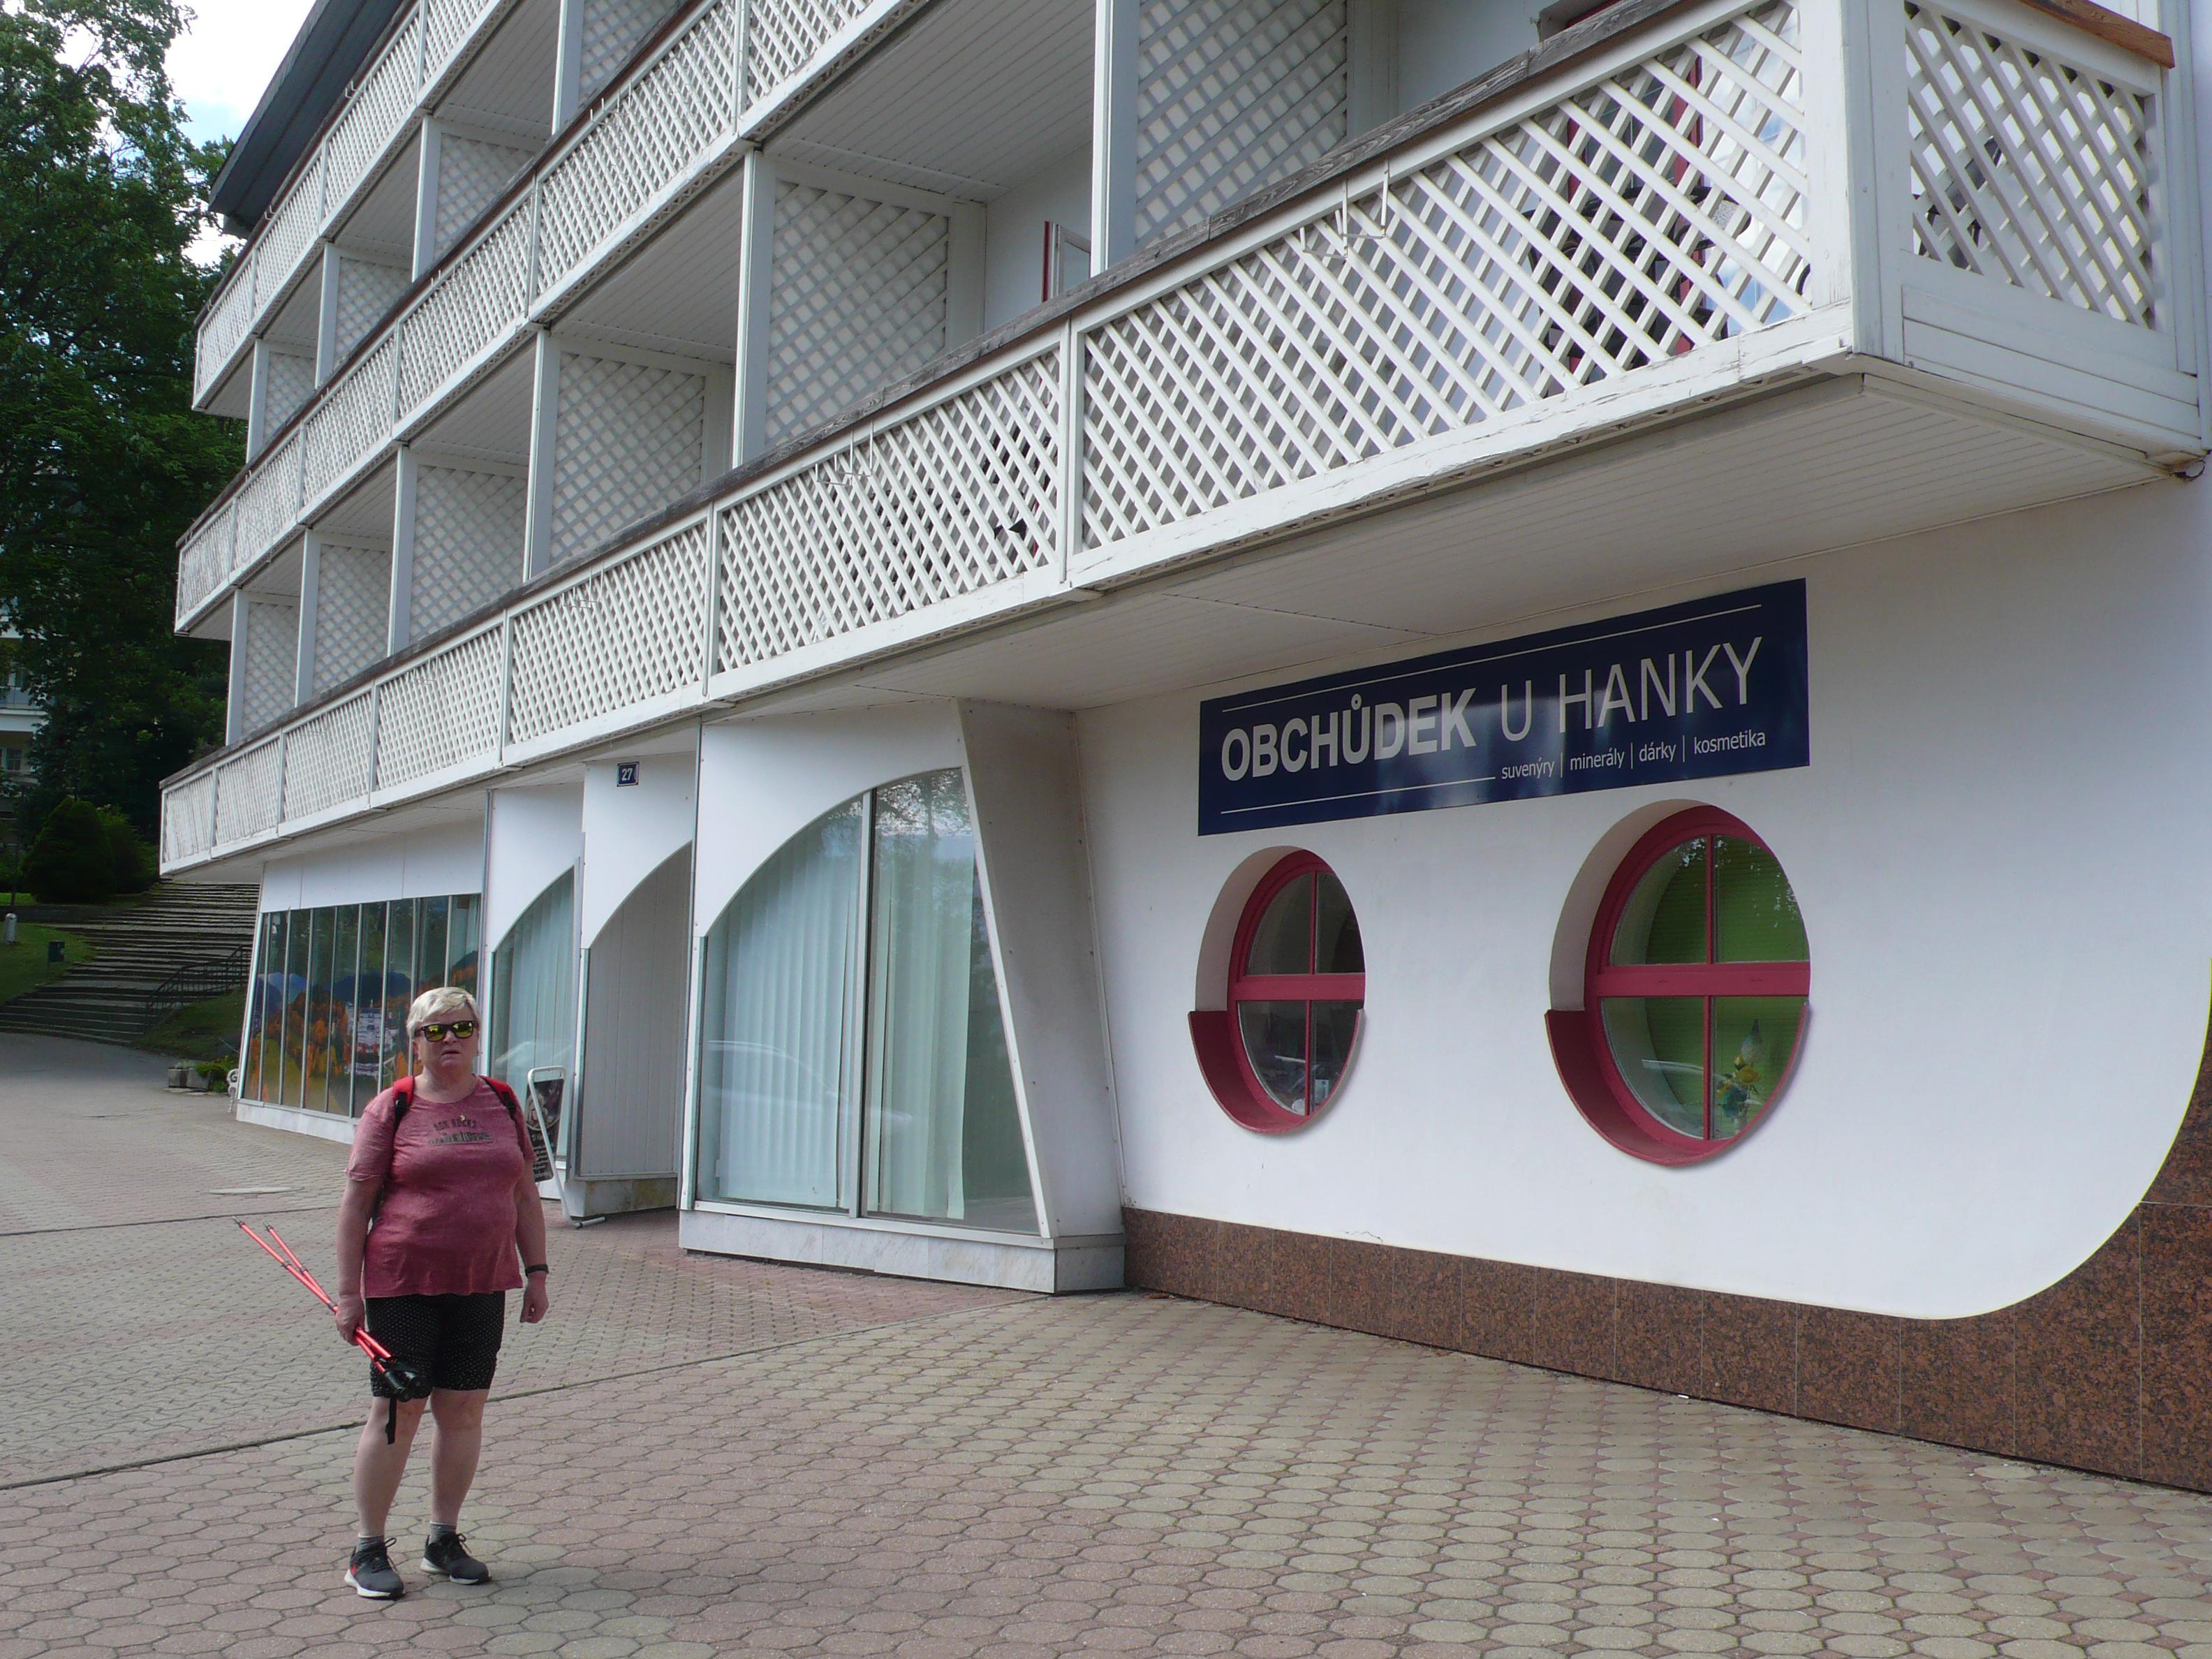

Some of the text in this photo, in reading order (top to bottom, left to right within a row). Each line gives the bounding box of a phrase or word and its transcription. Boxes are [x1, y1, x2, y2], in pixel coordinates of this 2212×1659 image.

[1221, 636, 1763, 782] OBCHŮDEK U HANKY
[621, 767, 633, 781] 27
[1501, 729, 1767, 780] suvenýry minerály dárky kosmetika
